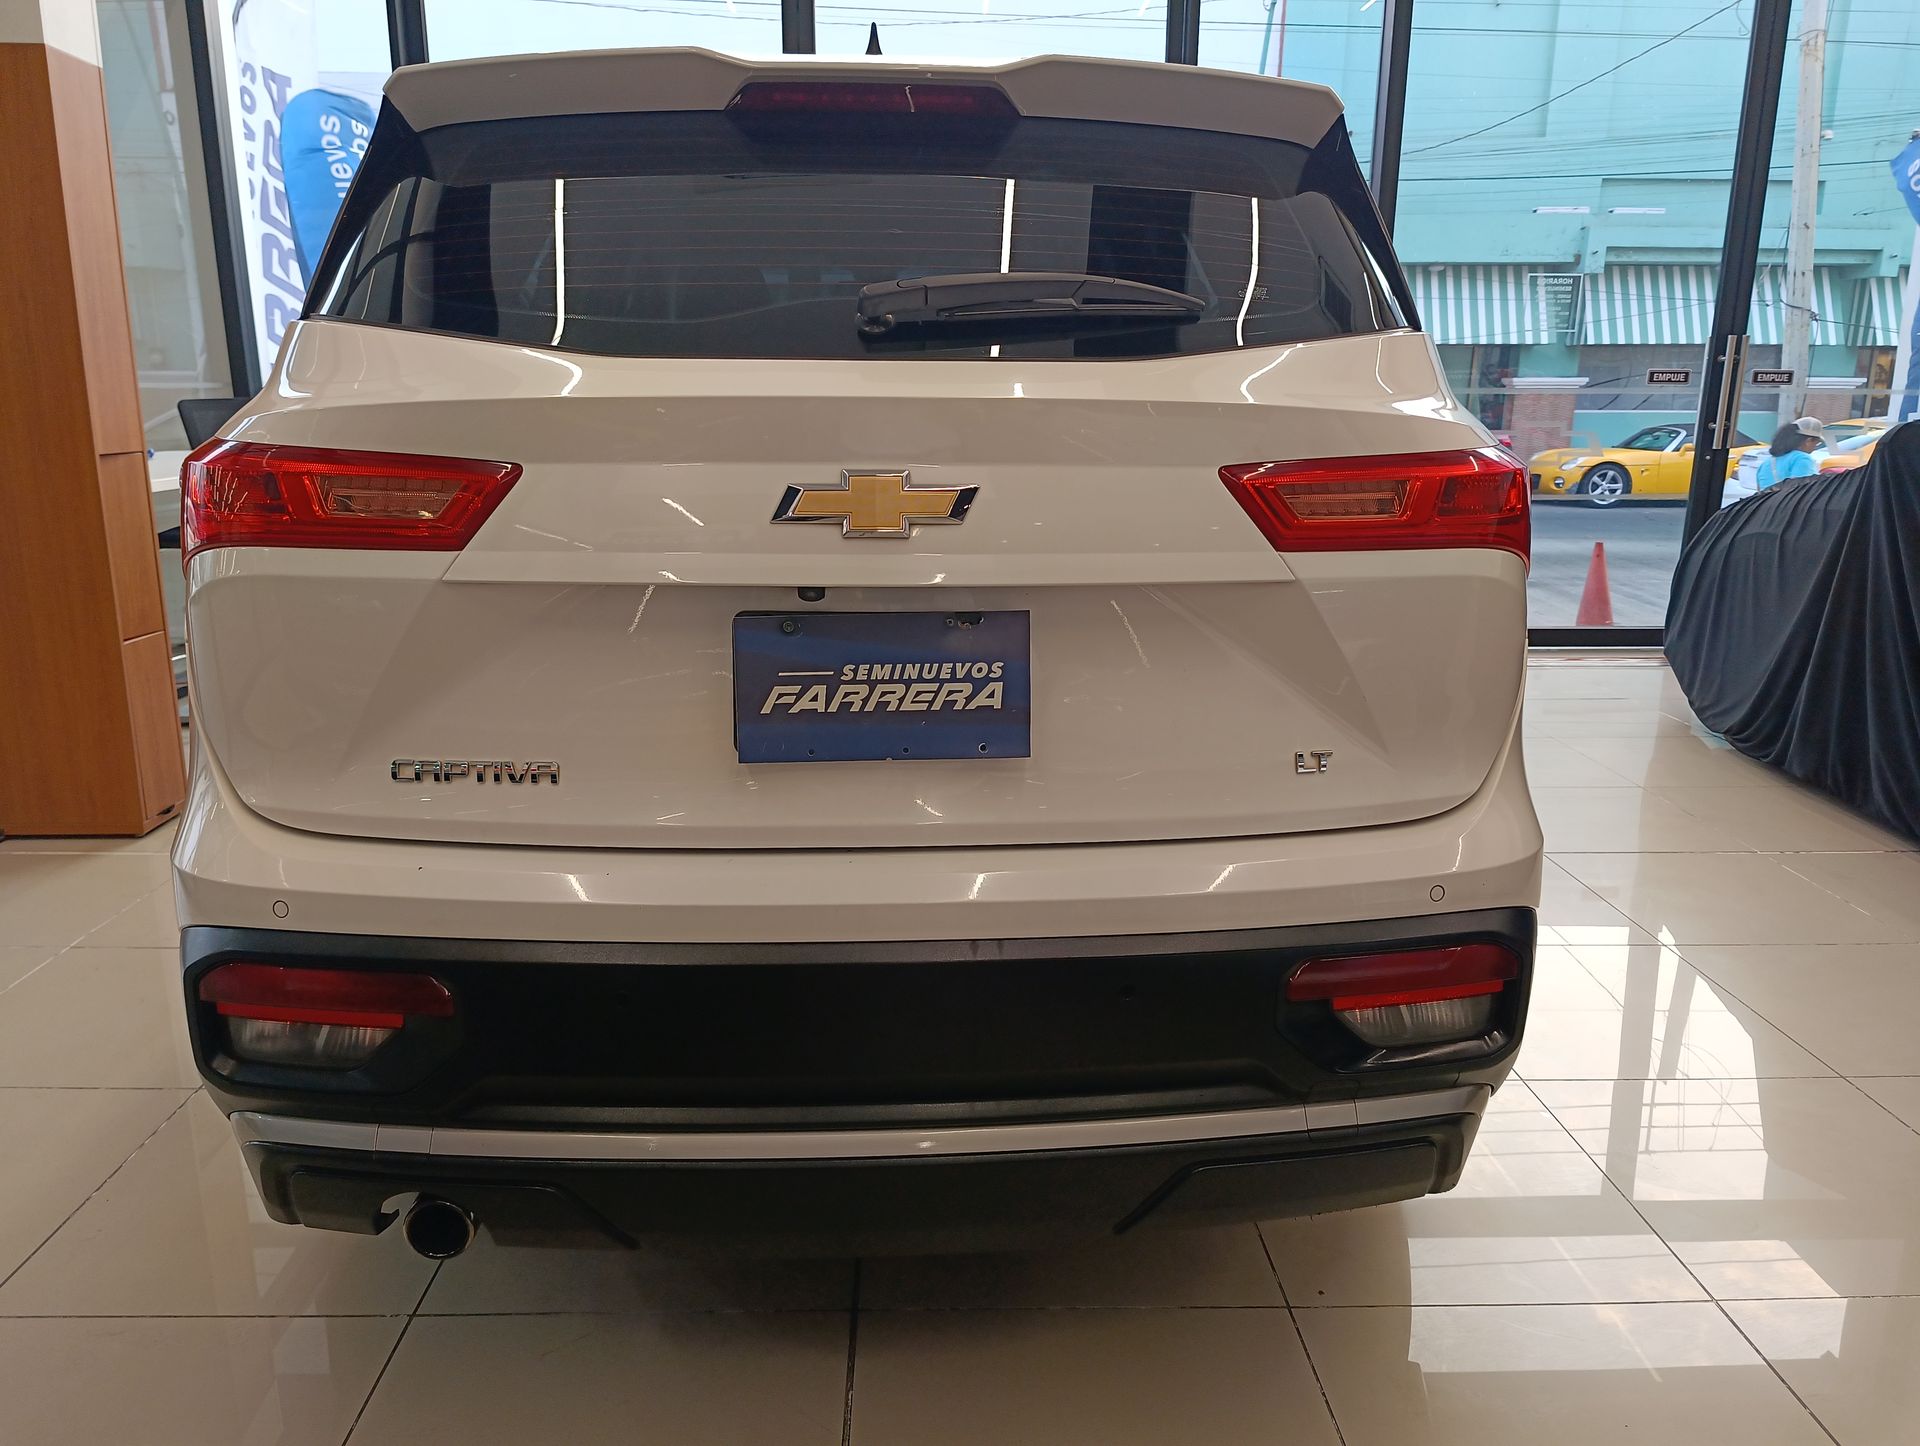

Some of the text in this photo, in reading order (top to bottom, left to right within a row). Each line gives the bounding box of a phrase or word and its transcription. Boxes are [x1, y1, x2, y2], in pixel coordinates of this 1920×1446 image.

[1653, 373, 1686, 381] EMPUJE
[1757, 373, 1790, 382] EMPUJE
[841, 661, 1004, 681] SEMINUEVOS
[760, 681, 1004, 714] FARRERA
[391, 758, 560, 785] CAPTIVA
[1295, 749, 1334, 774] LT
